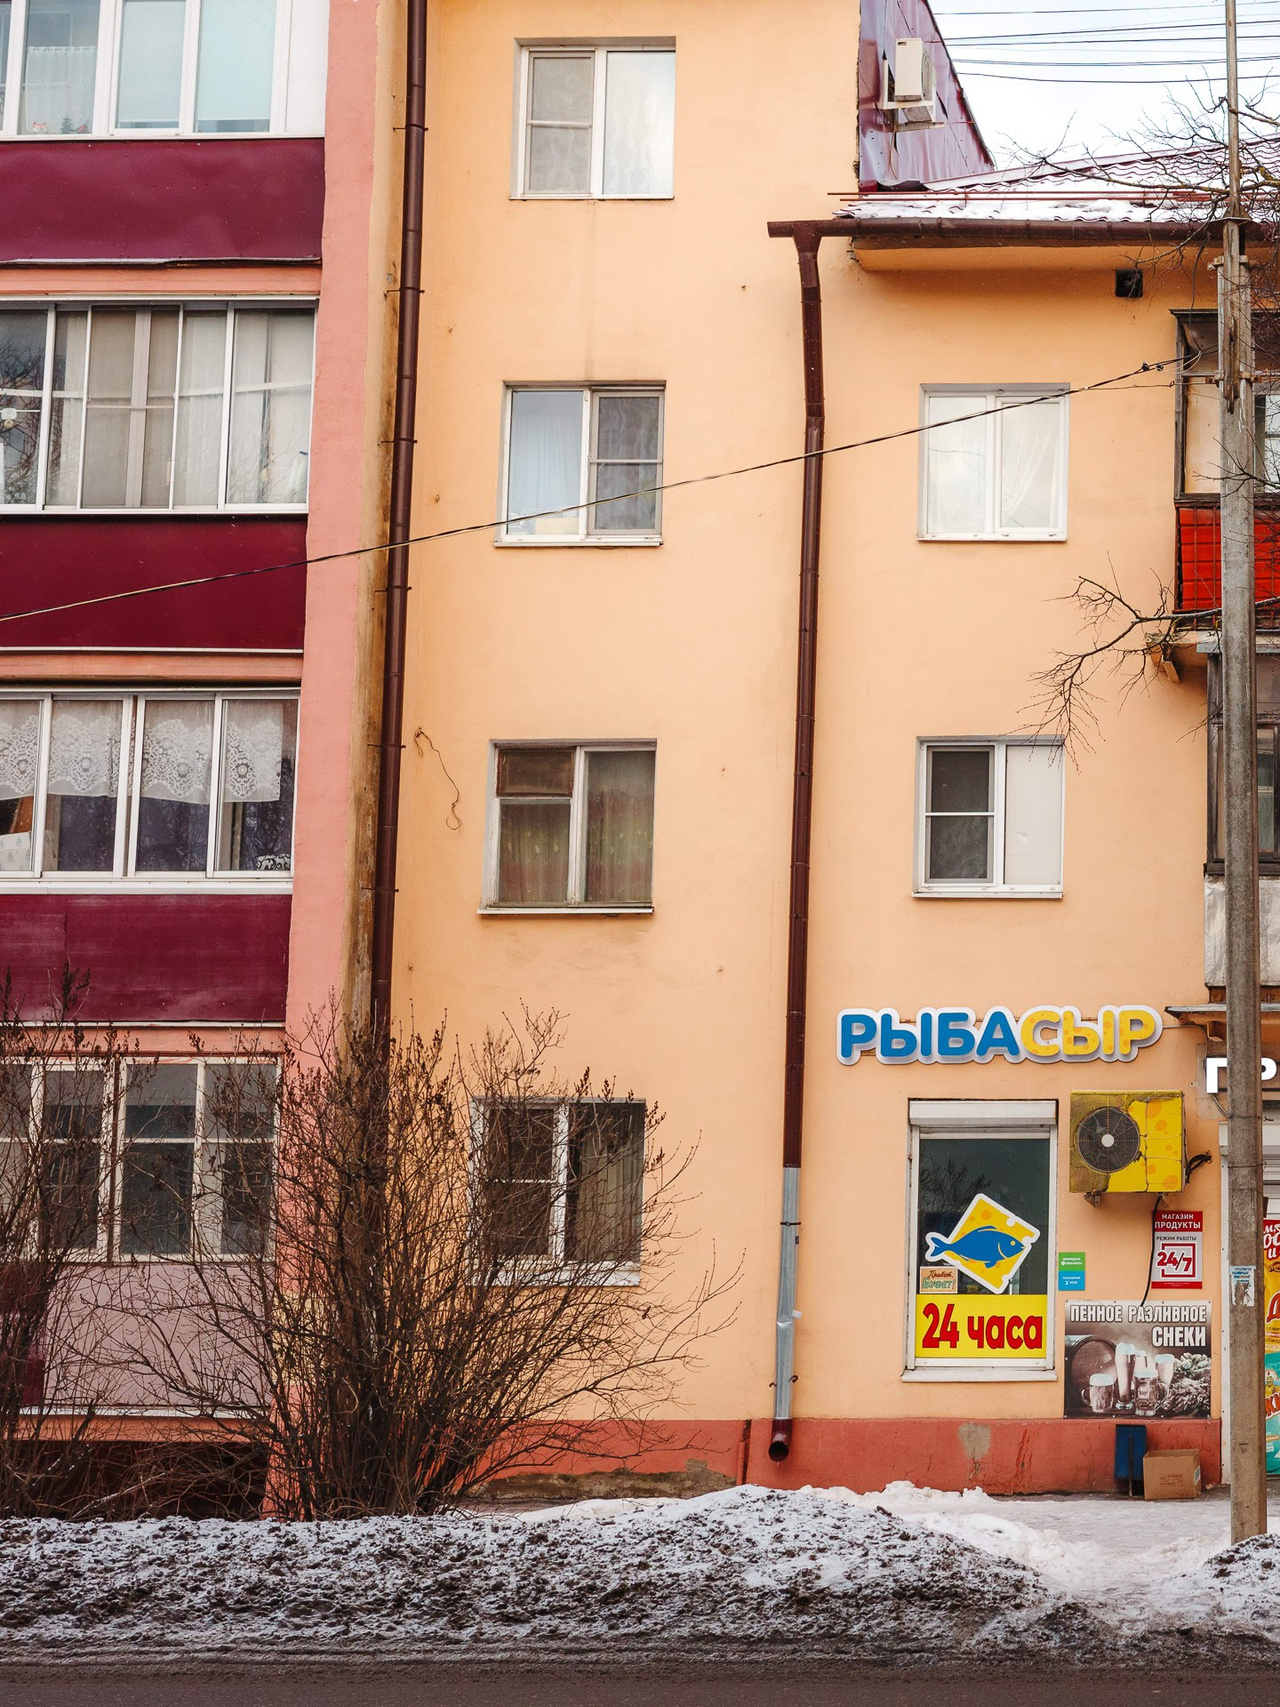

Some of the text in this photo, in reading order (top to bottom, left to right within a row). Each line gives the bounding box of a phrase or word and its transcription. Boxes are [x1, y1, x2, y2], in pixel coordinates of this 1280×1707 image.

[1154, 1221, 1201, 1229] ПРОДУКТЫ
[1157, 1251, 1192, 1272] 24/7
[1267, 1247, 1277, 1259] и
[1070, 1305, 1207, 1324] ПЕННОЕ РАЗЛИВНОЕ
[922, 1303, 1043, 1350] 24 часа
[1152, 1326, 1206, 1348] СНЕКИ
